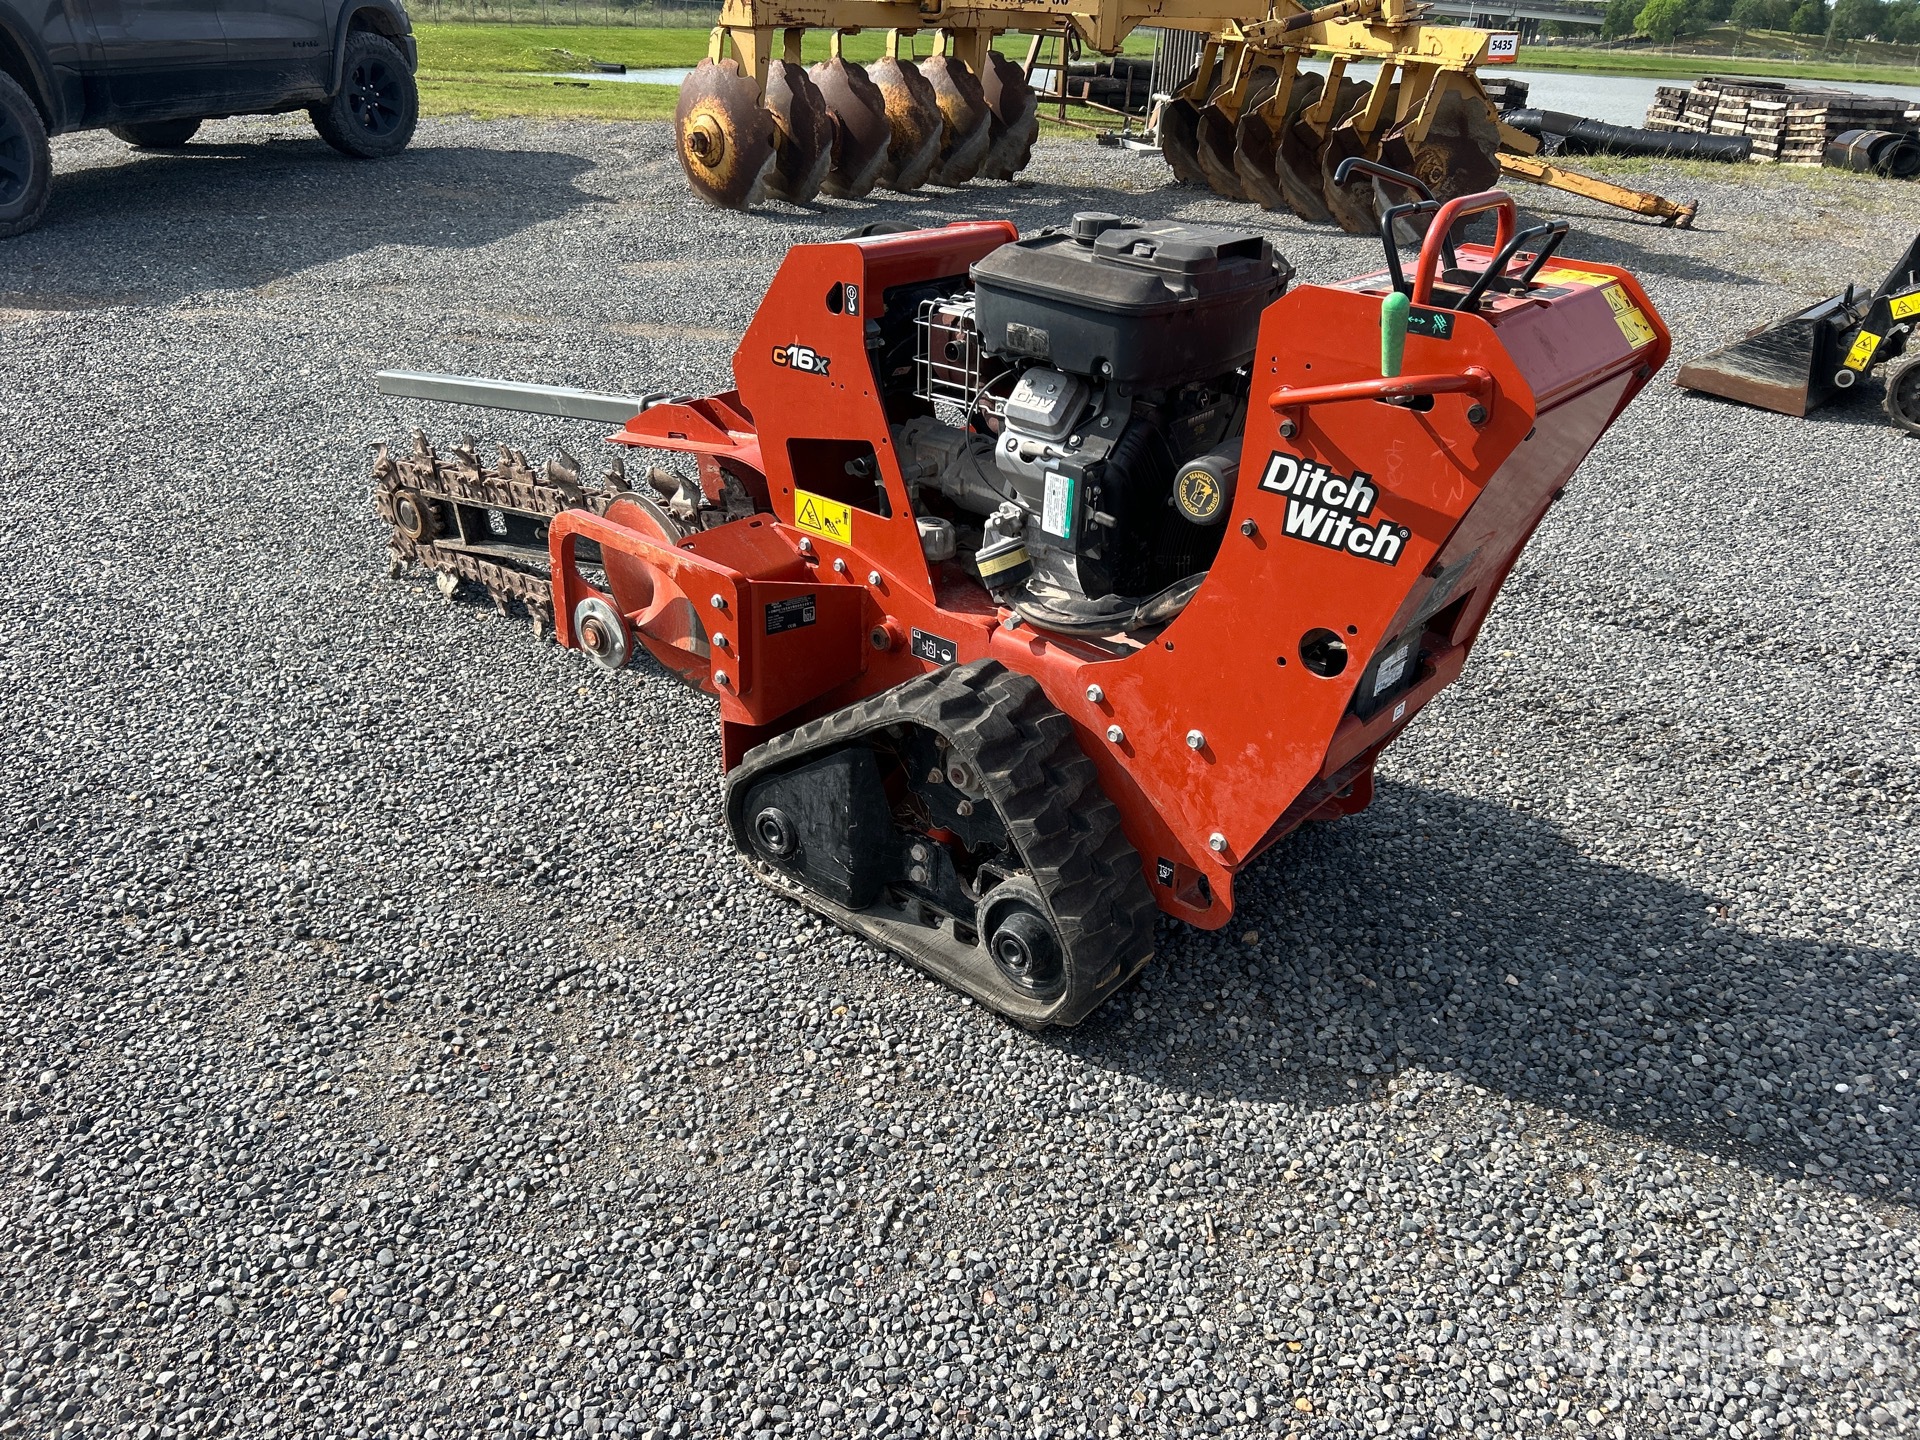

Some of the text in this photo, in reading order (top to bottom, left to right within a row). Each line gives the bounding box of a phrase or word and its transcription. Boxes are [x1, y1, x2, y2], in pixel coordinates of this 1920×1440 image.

[1491, 39, 1513, 51] 5435
[1189, 472, 1212, 485] MANUAL
[1263, 455, 1375, 513] Ditch
